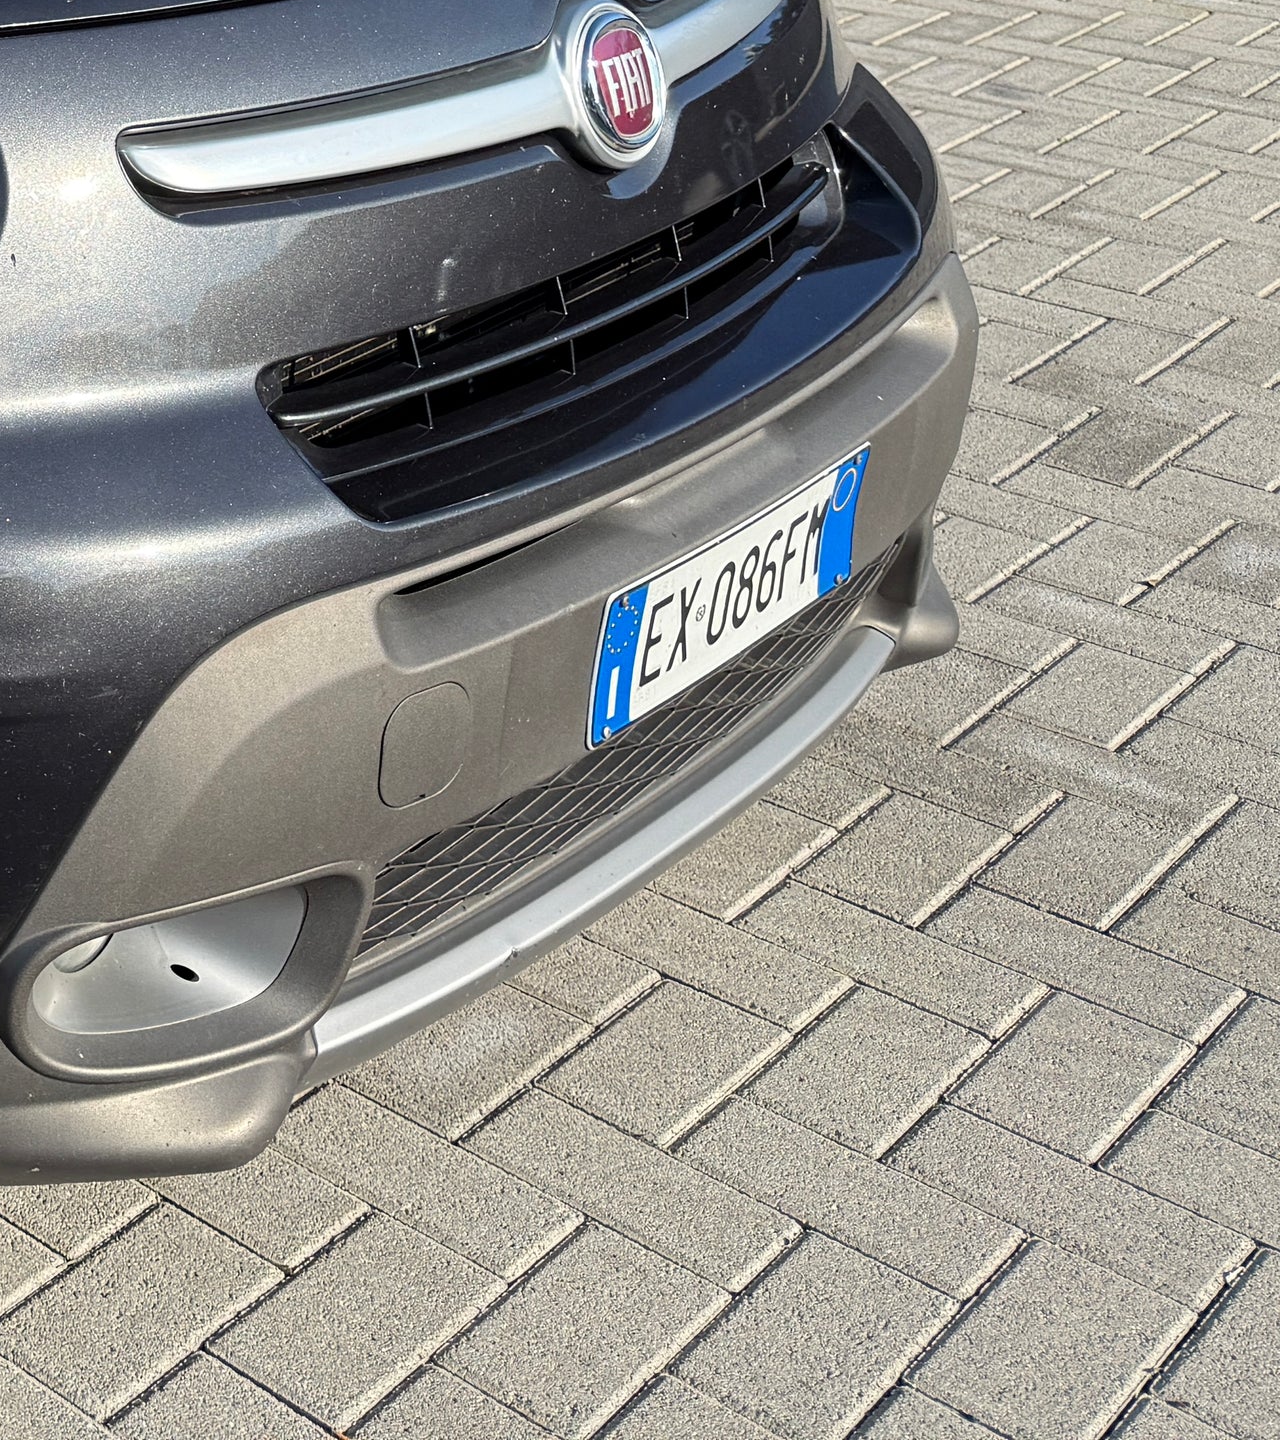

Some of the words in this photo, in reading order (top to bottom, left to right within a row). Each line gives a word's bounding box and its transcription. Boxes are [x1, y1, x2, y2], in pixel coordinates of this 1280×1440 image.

[601, 47, 651, 118] FIAT
[606, 665, 621, 720] I
[639, 577, 702, 687] EX
[706, 495, 832, 646] 086FM
